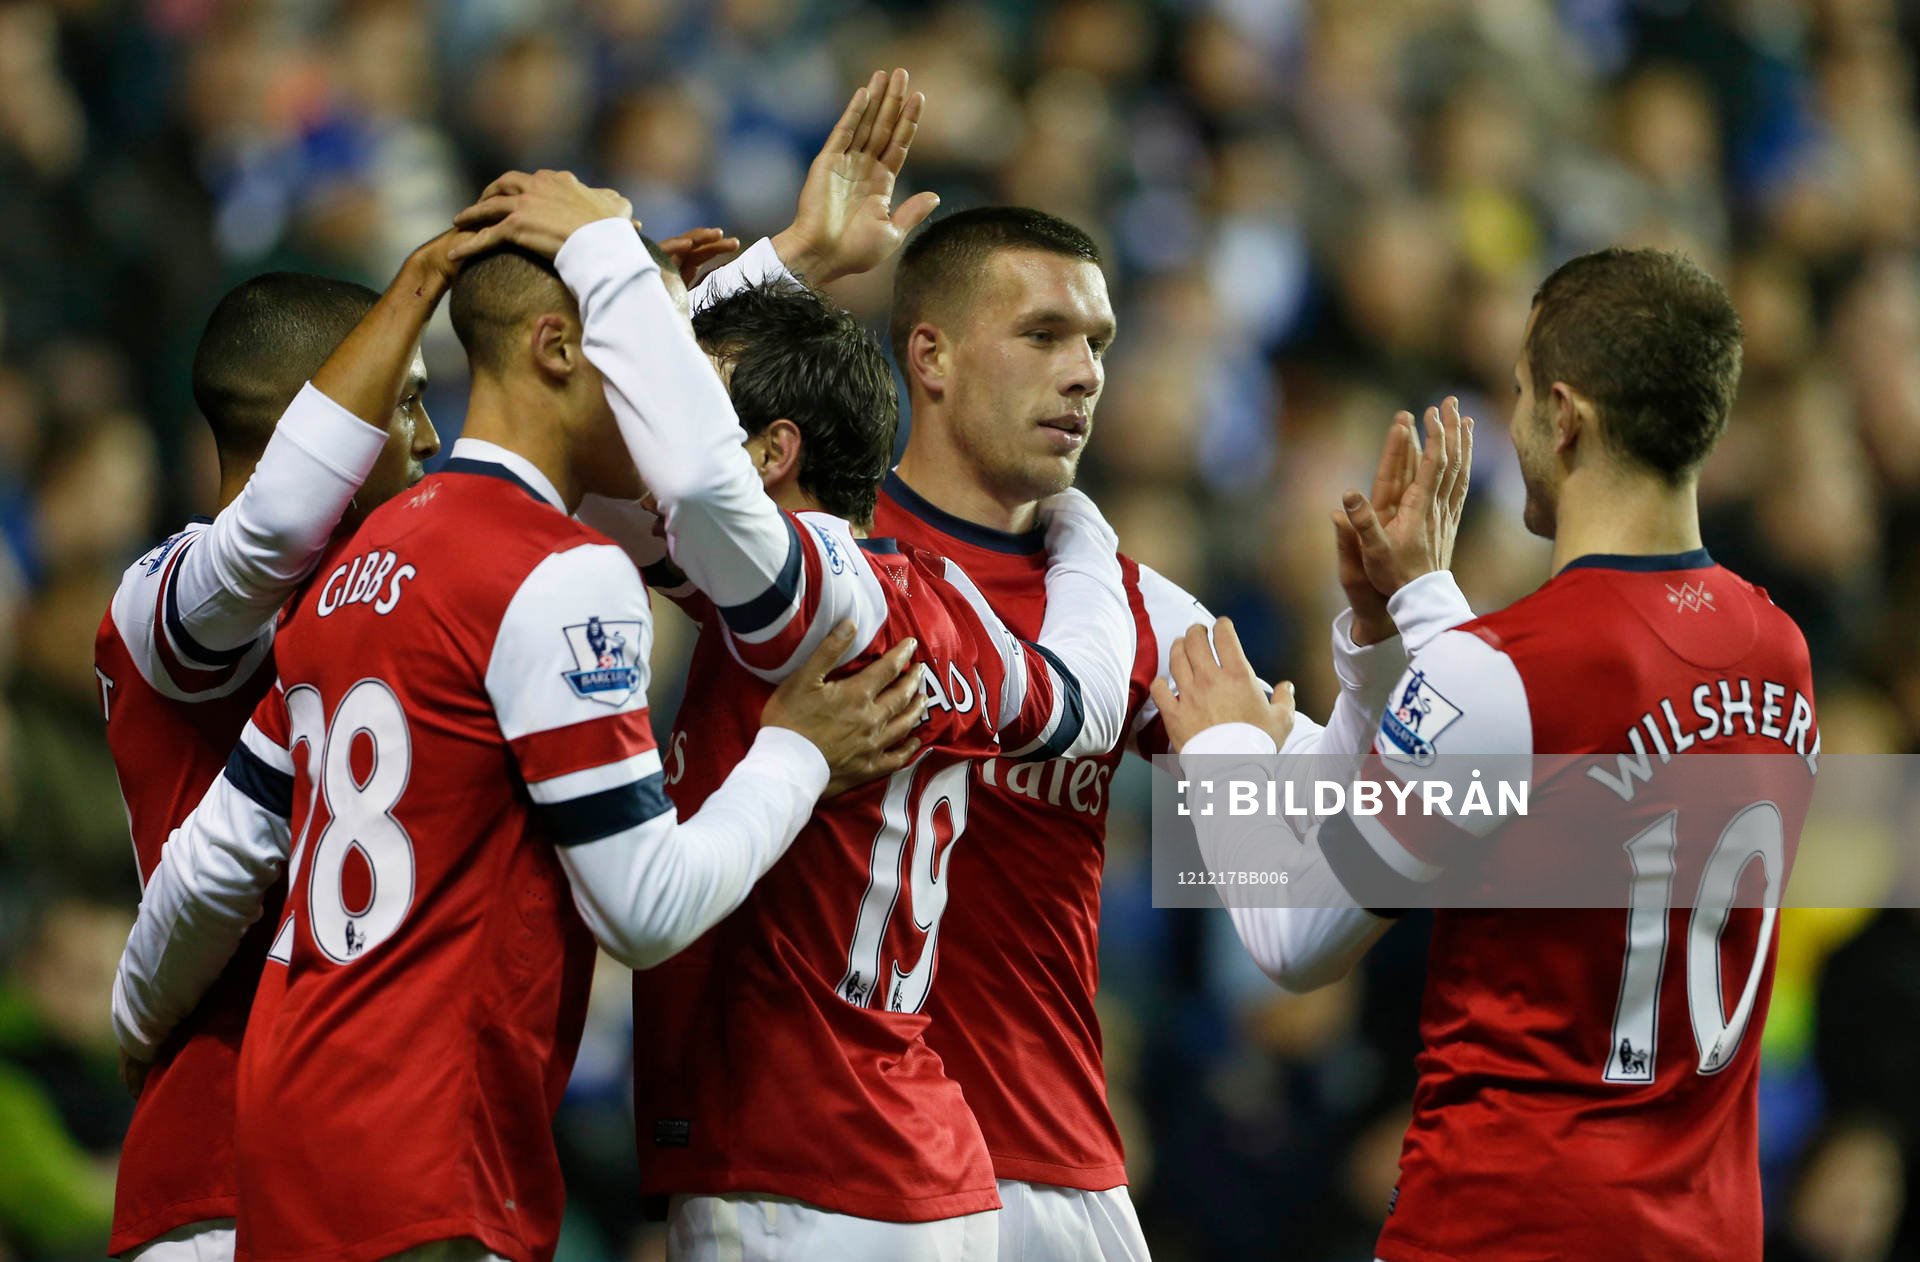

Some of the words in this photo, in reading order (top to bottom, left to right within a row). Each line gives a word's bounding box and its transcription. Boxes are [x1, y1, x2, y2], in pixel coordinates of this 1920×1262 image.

[317, 550, 417, 618] GIBBS
[267, 677, 415, 965] 28
[836, 747, 973, 1014] 19
[1601, 800, 1785, 1085] 10
